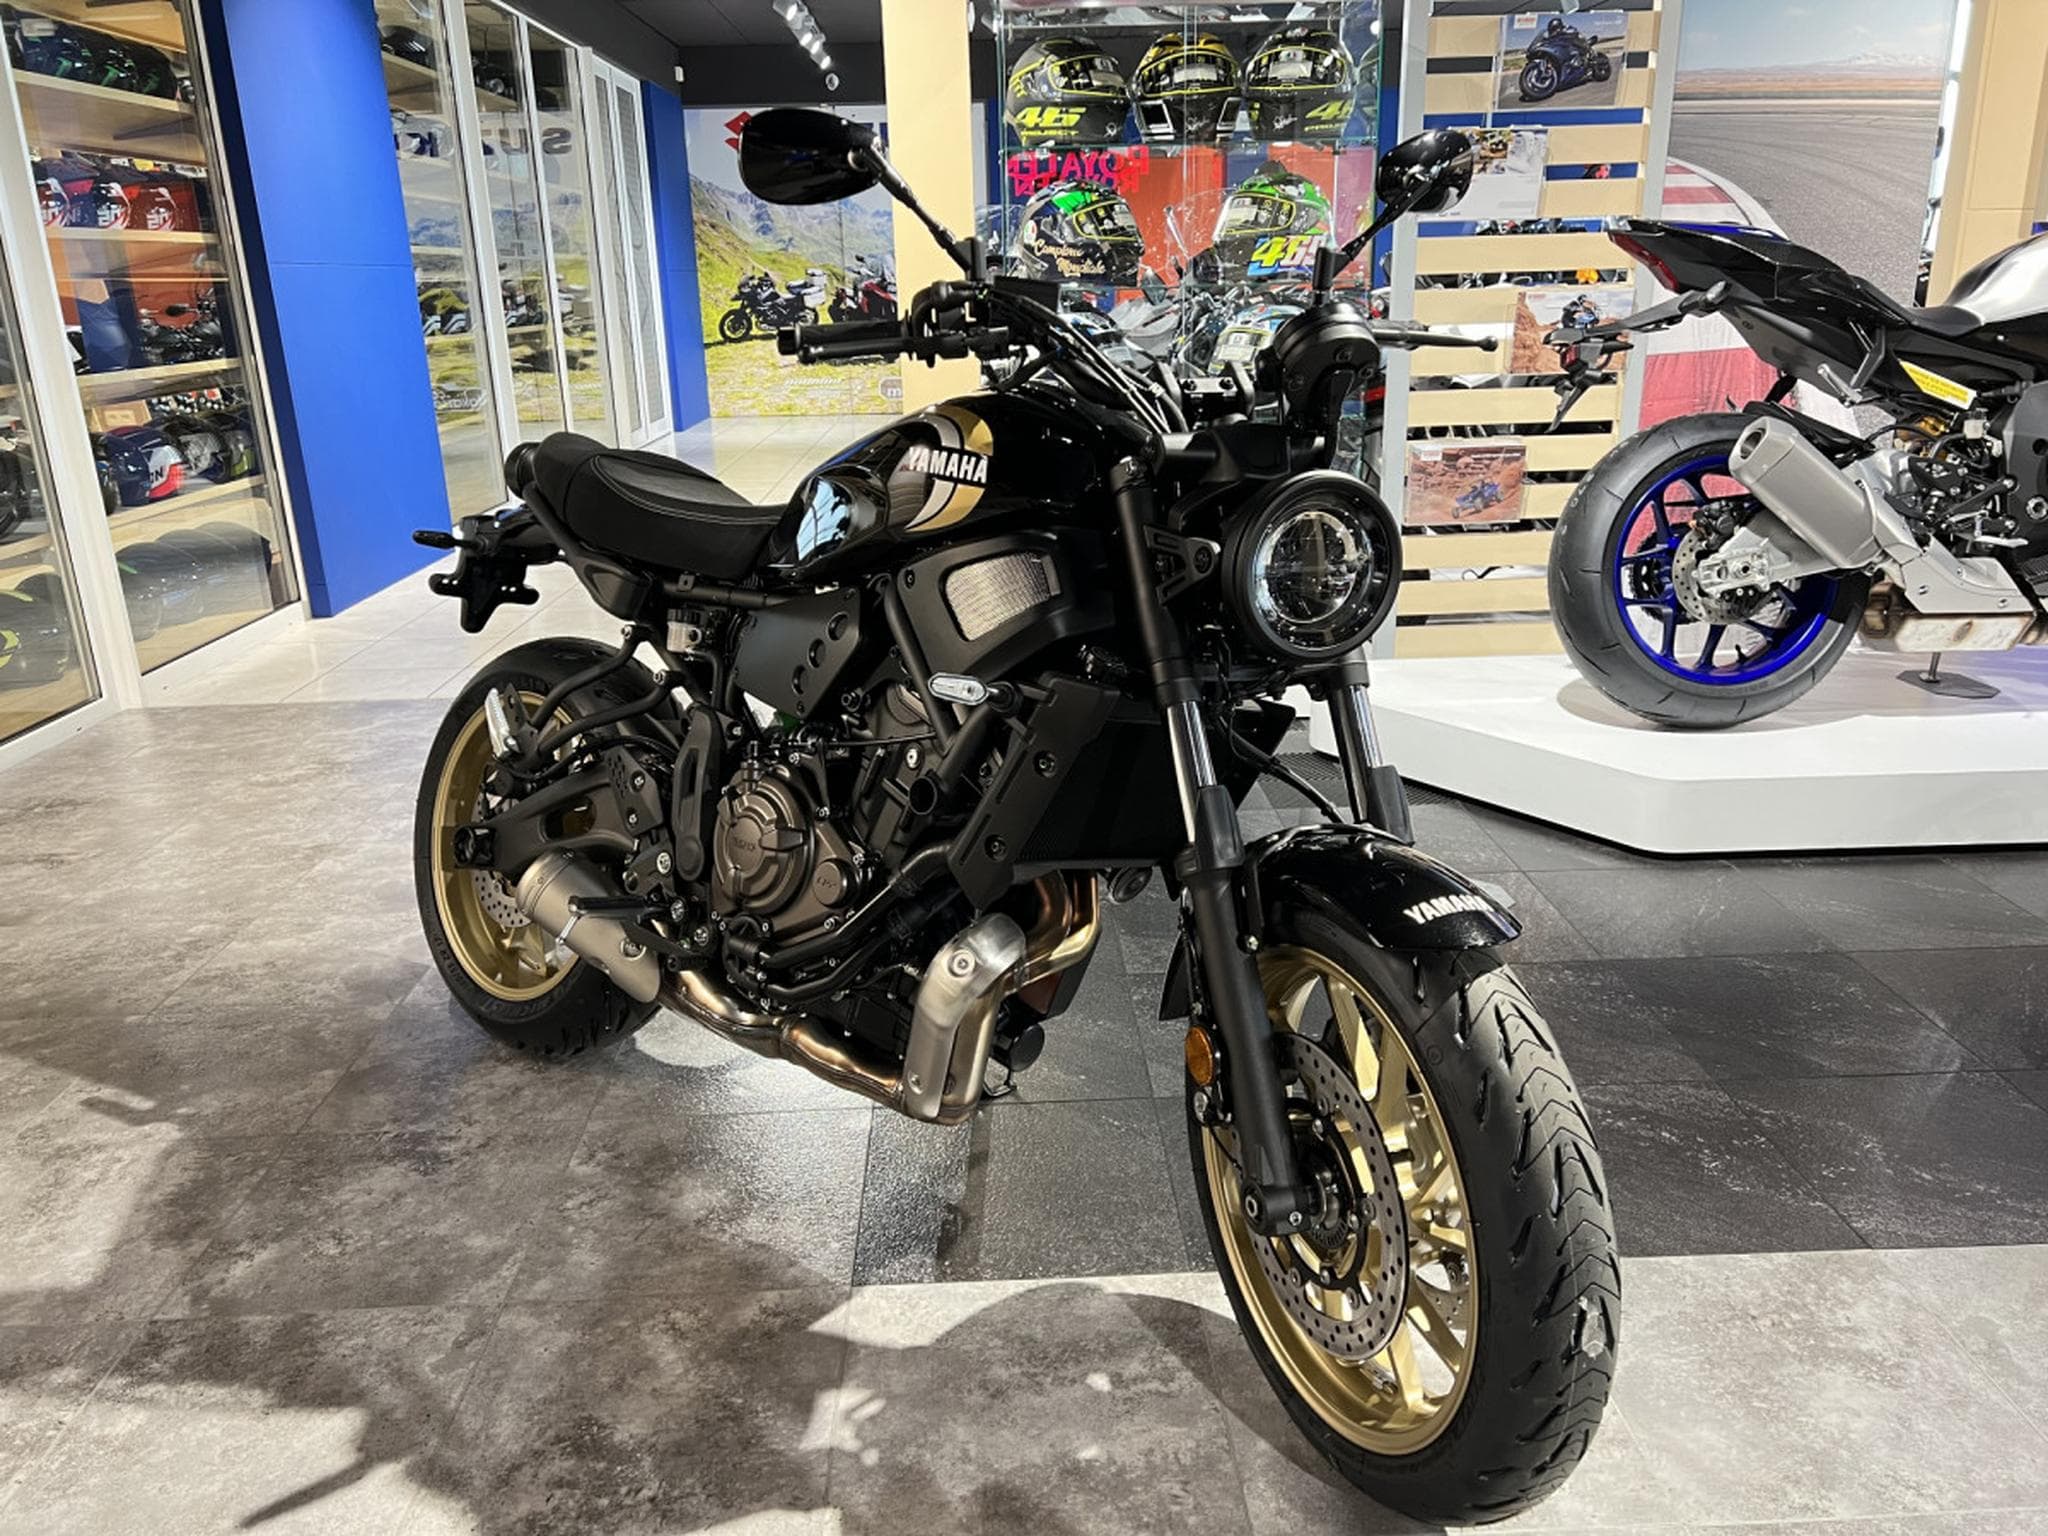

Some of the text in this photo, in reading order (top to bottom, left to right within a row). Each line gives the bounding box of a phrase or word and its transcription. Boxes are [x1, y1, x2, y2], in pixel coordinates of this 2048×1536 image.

[1015, 107, 1087, 128] 46
[908, 446, 988, 484] YAMAHA
[1402, 894, 1495, 925] YAMAHA
